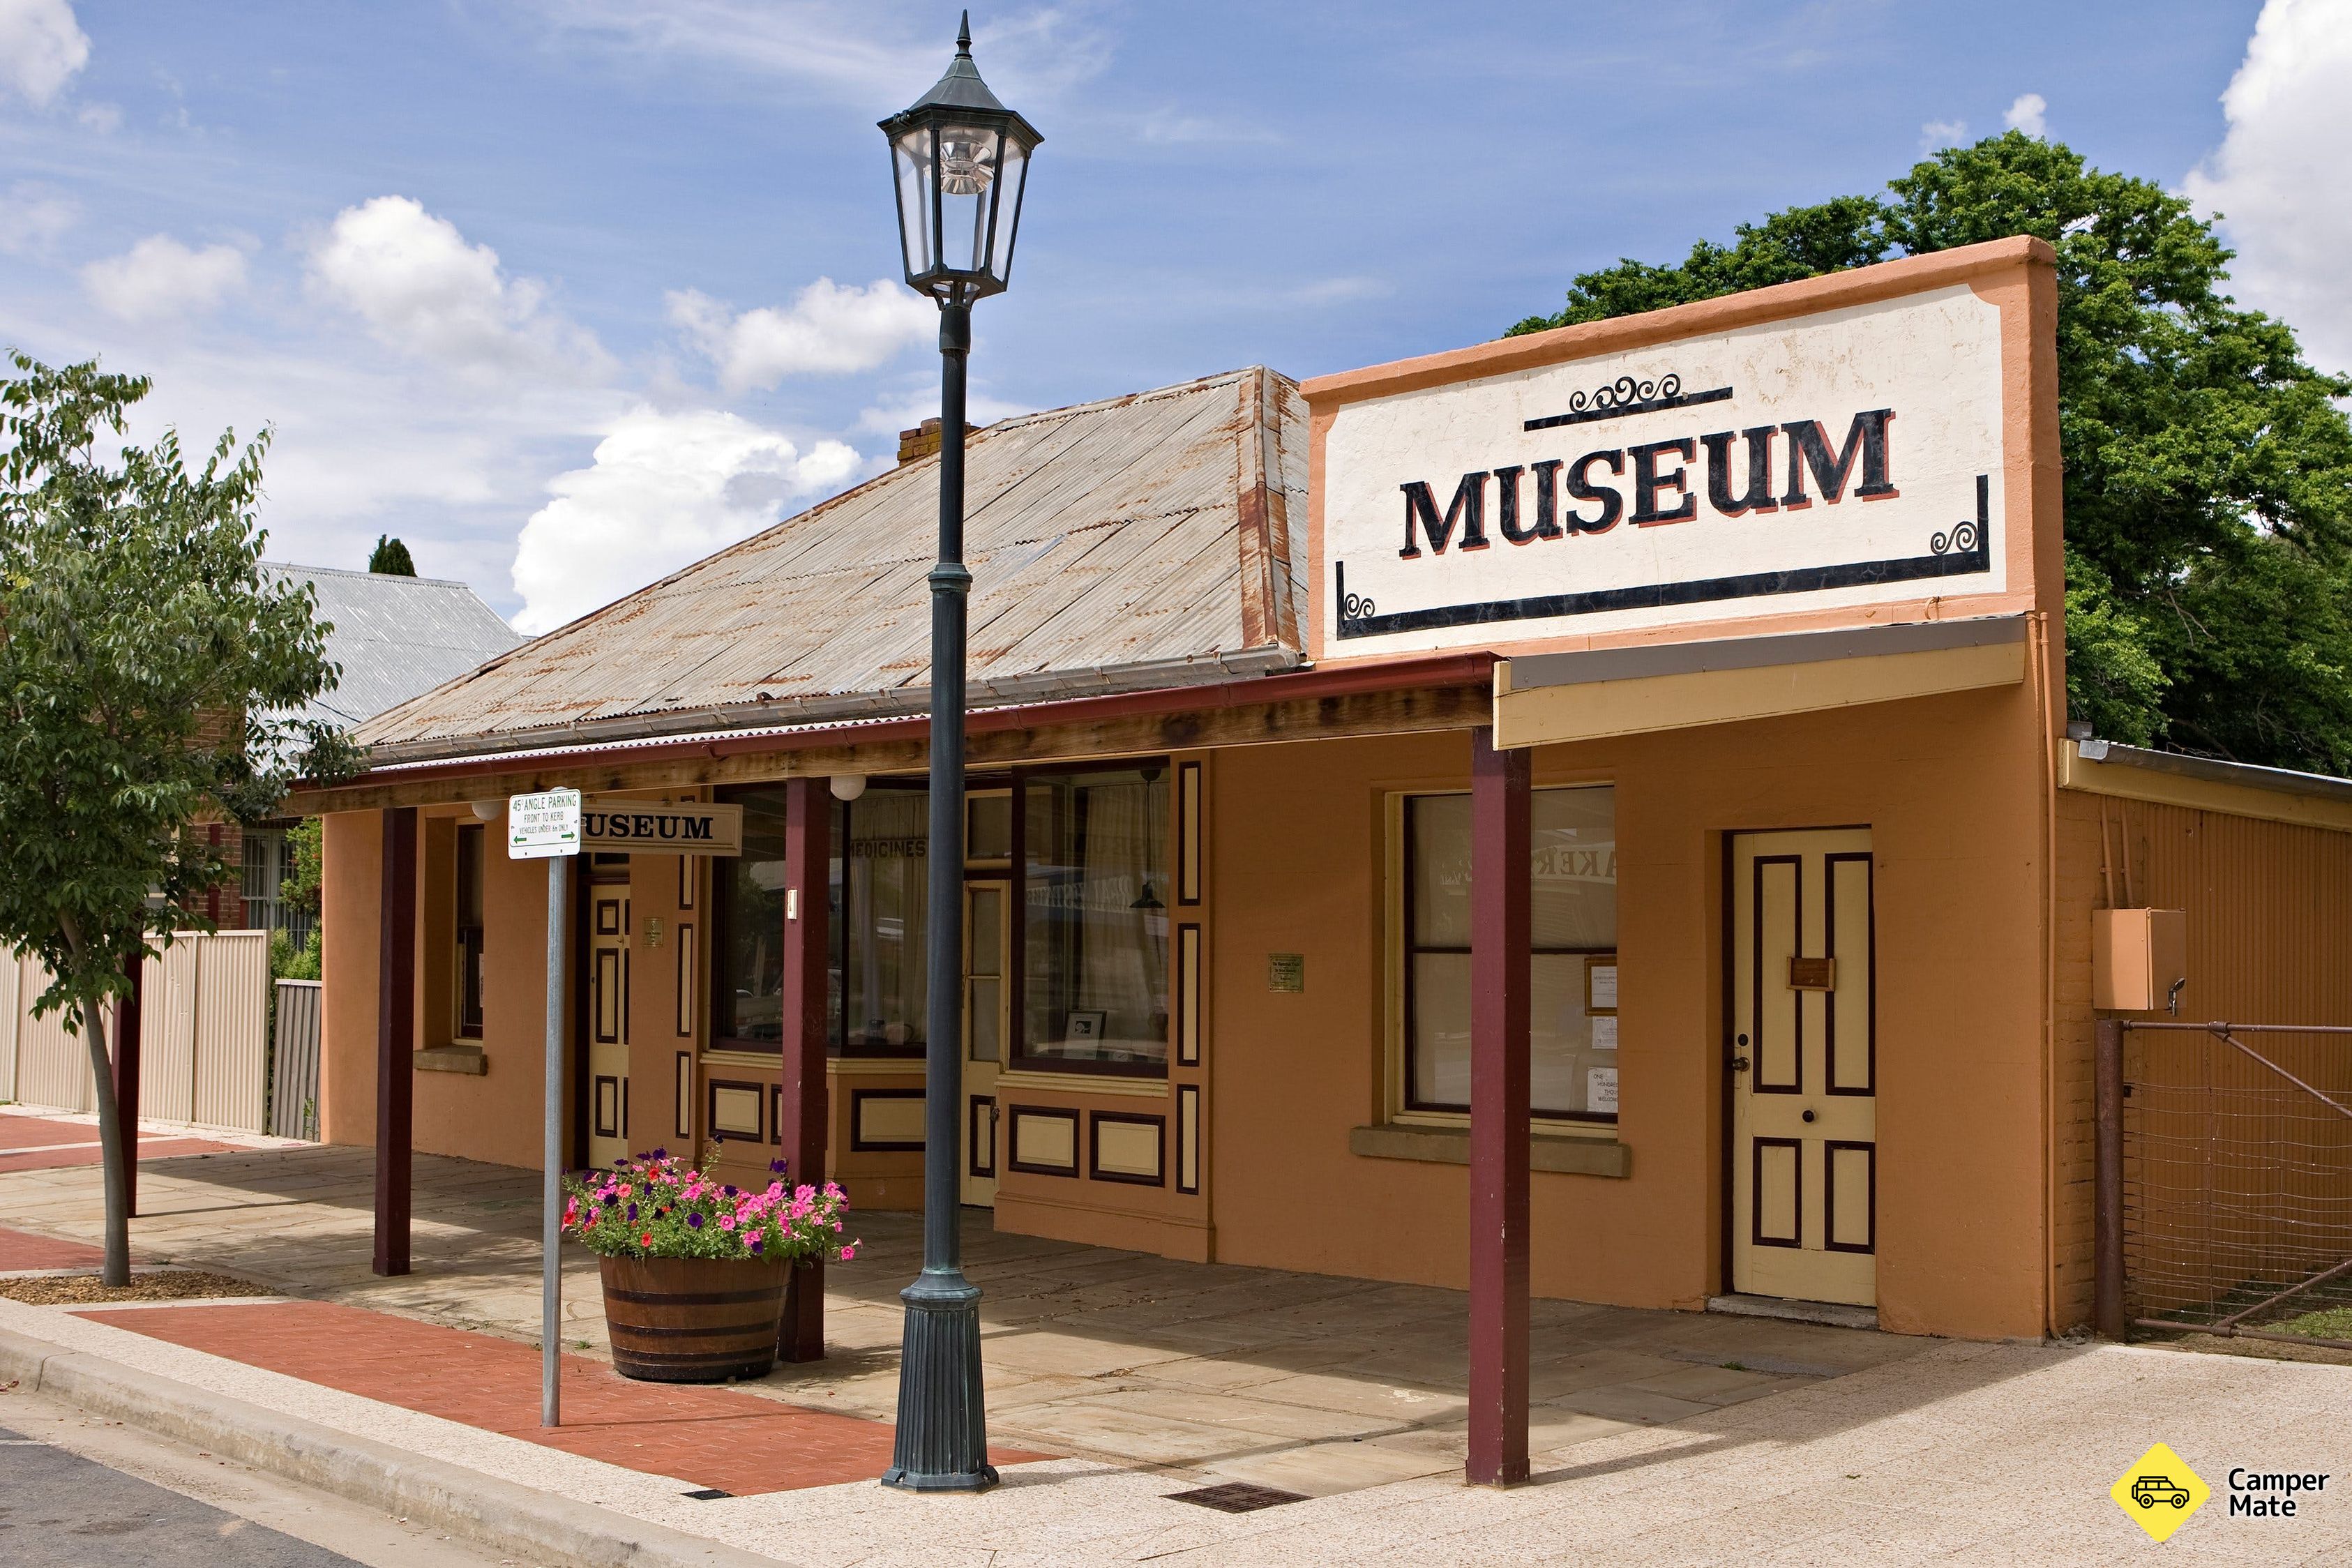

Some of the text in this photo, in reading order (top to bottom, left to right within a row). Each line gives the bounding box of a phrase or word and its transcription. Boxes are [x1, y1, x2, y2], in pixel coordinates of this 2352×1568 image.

[1399, 407, 1900, 560] MUSEUM
[524, 797, 545, 811] ANGLE
[548, 794, 577, 808] PARKING
[524, 811, 564, 823] FRONT TO KERB
[519, 826, 537, 835] VEHICLES
[582, 813, 714, 839] USEUM
